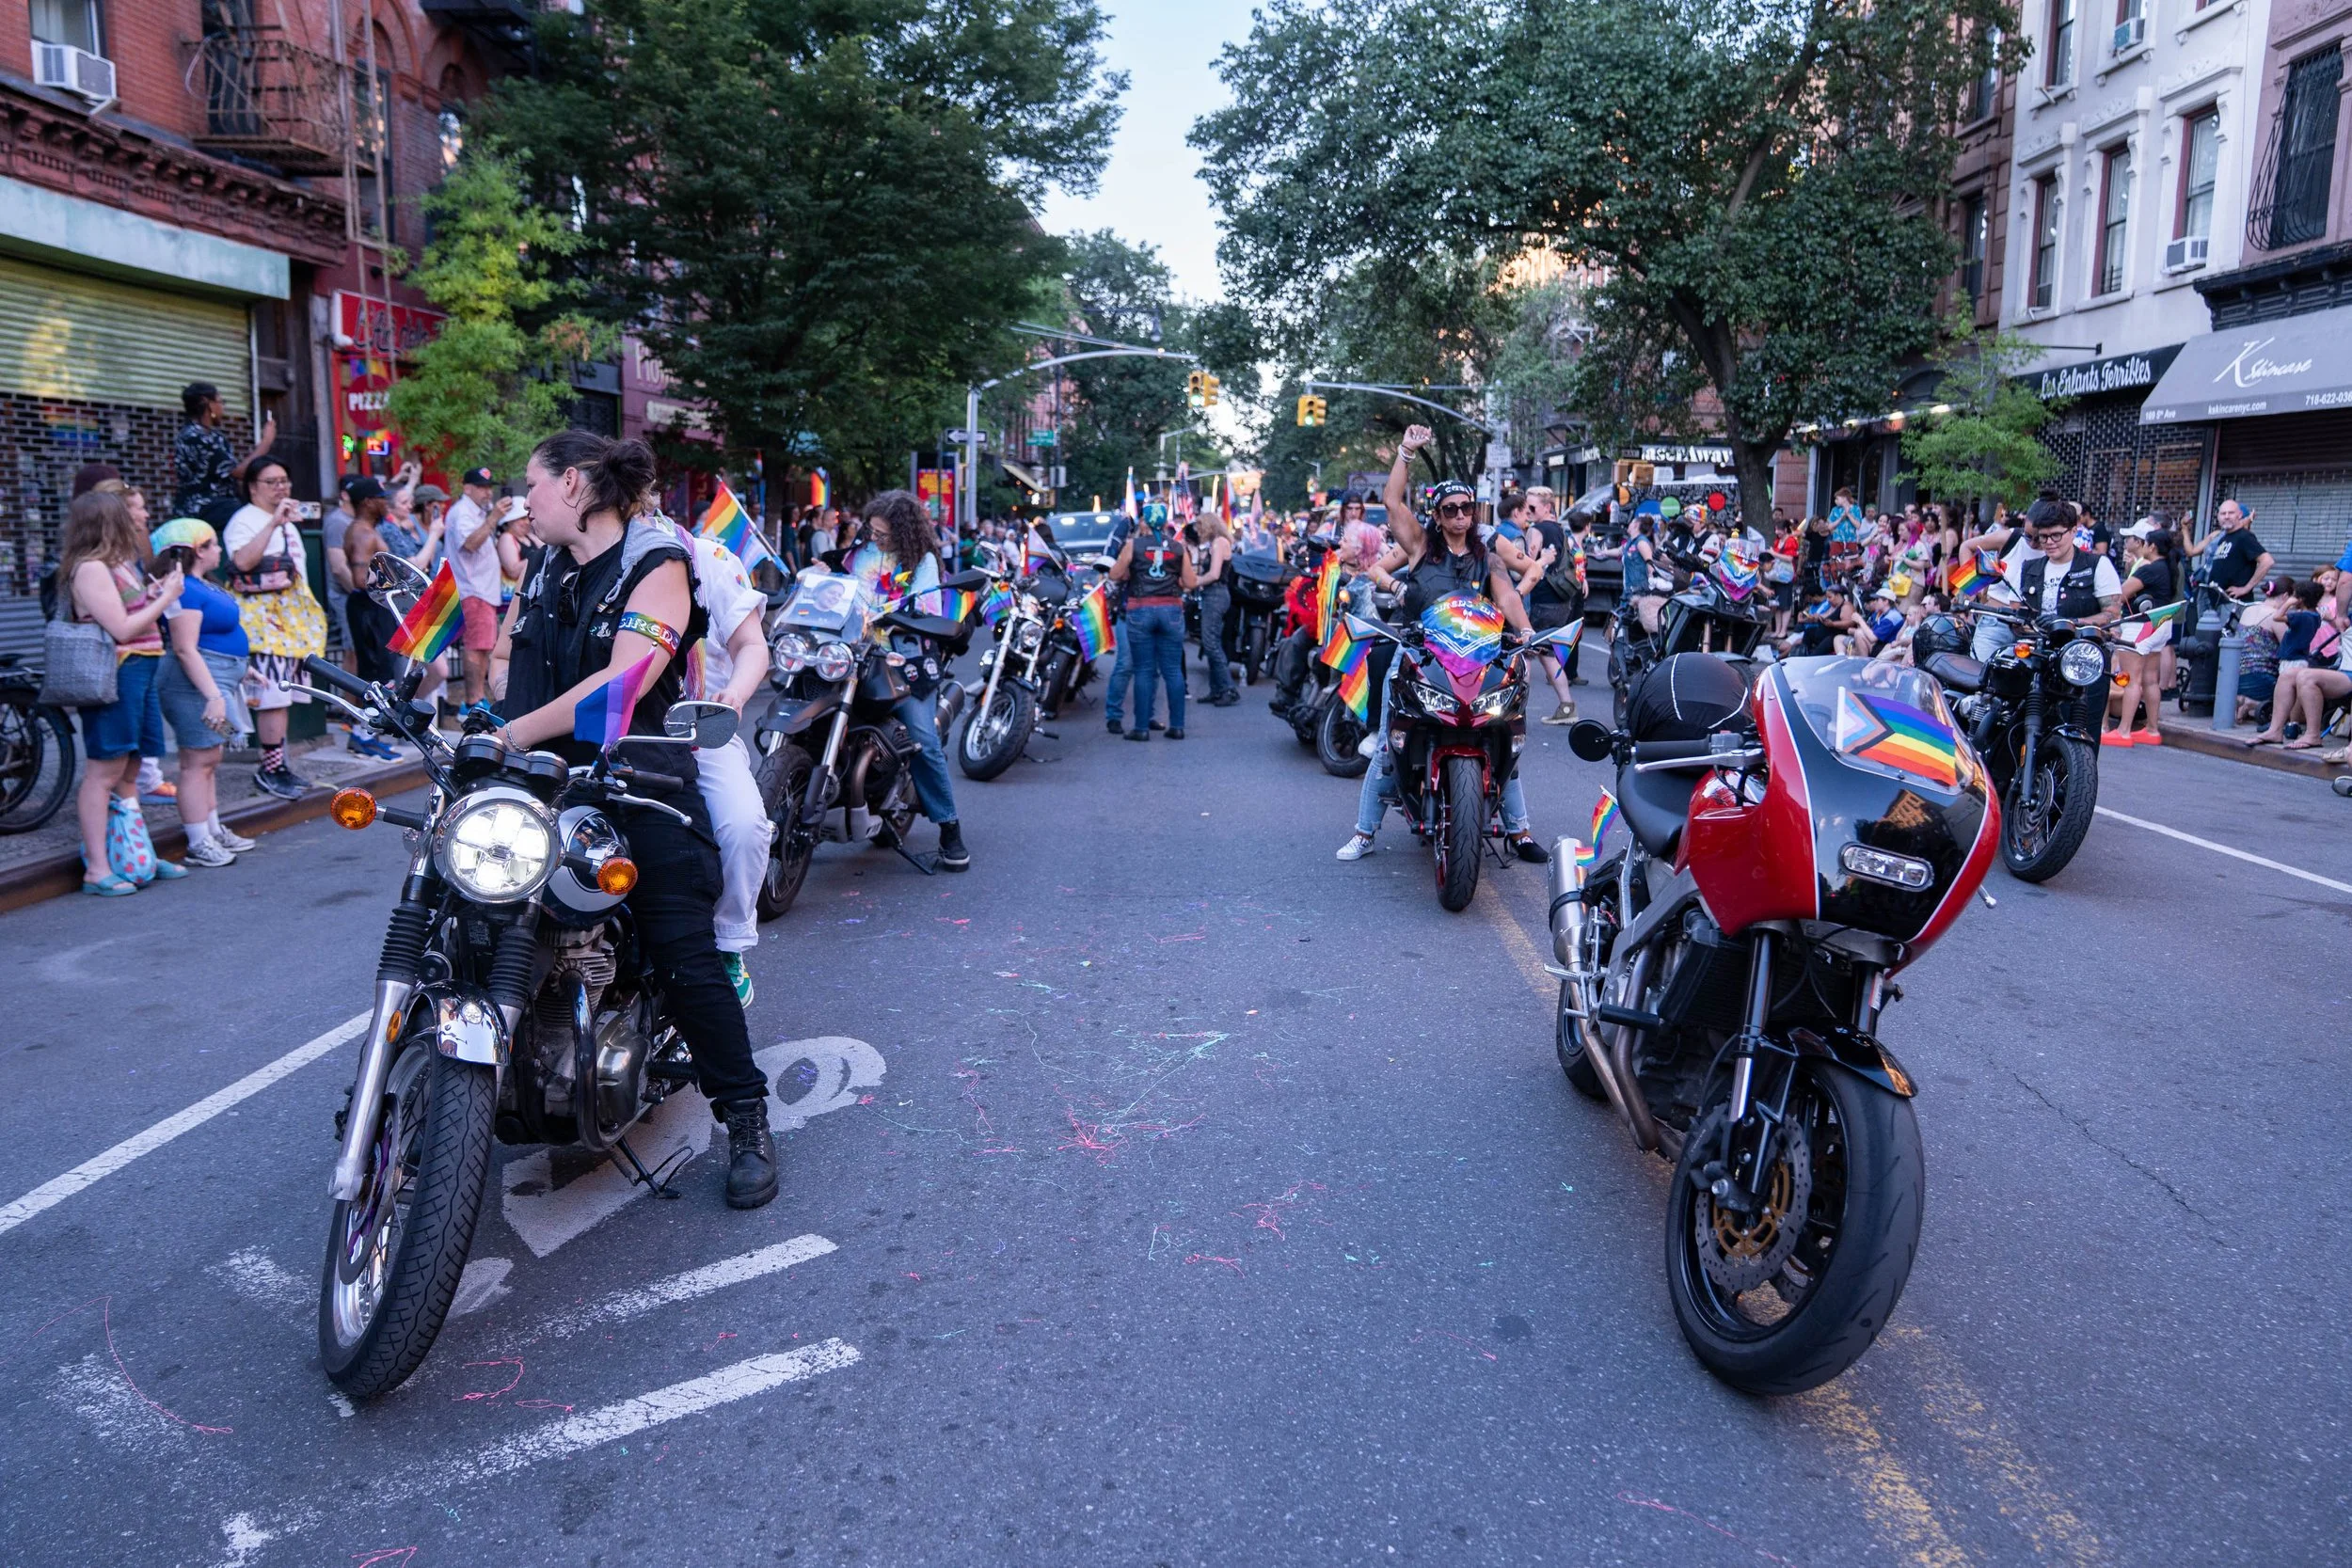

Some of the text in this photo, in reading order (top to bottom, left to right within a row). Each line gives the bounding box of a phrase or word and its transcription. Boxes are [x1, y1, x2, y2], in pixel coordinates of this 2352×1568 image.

[2040, 356, 2151, 400] Les Enfants Terribles
[2164, 408, 2176, 420] Ave
[2208, 401, 2266, 415] kskincarenyc.com
[1642, 445, 1732, 467] aserAway
